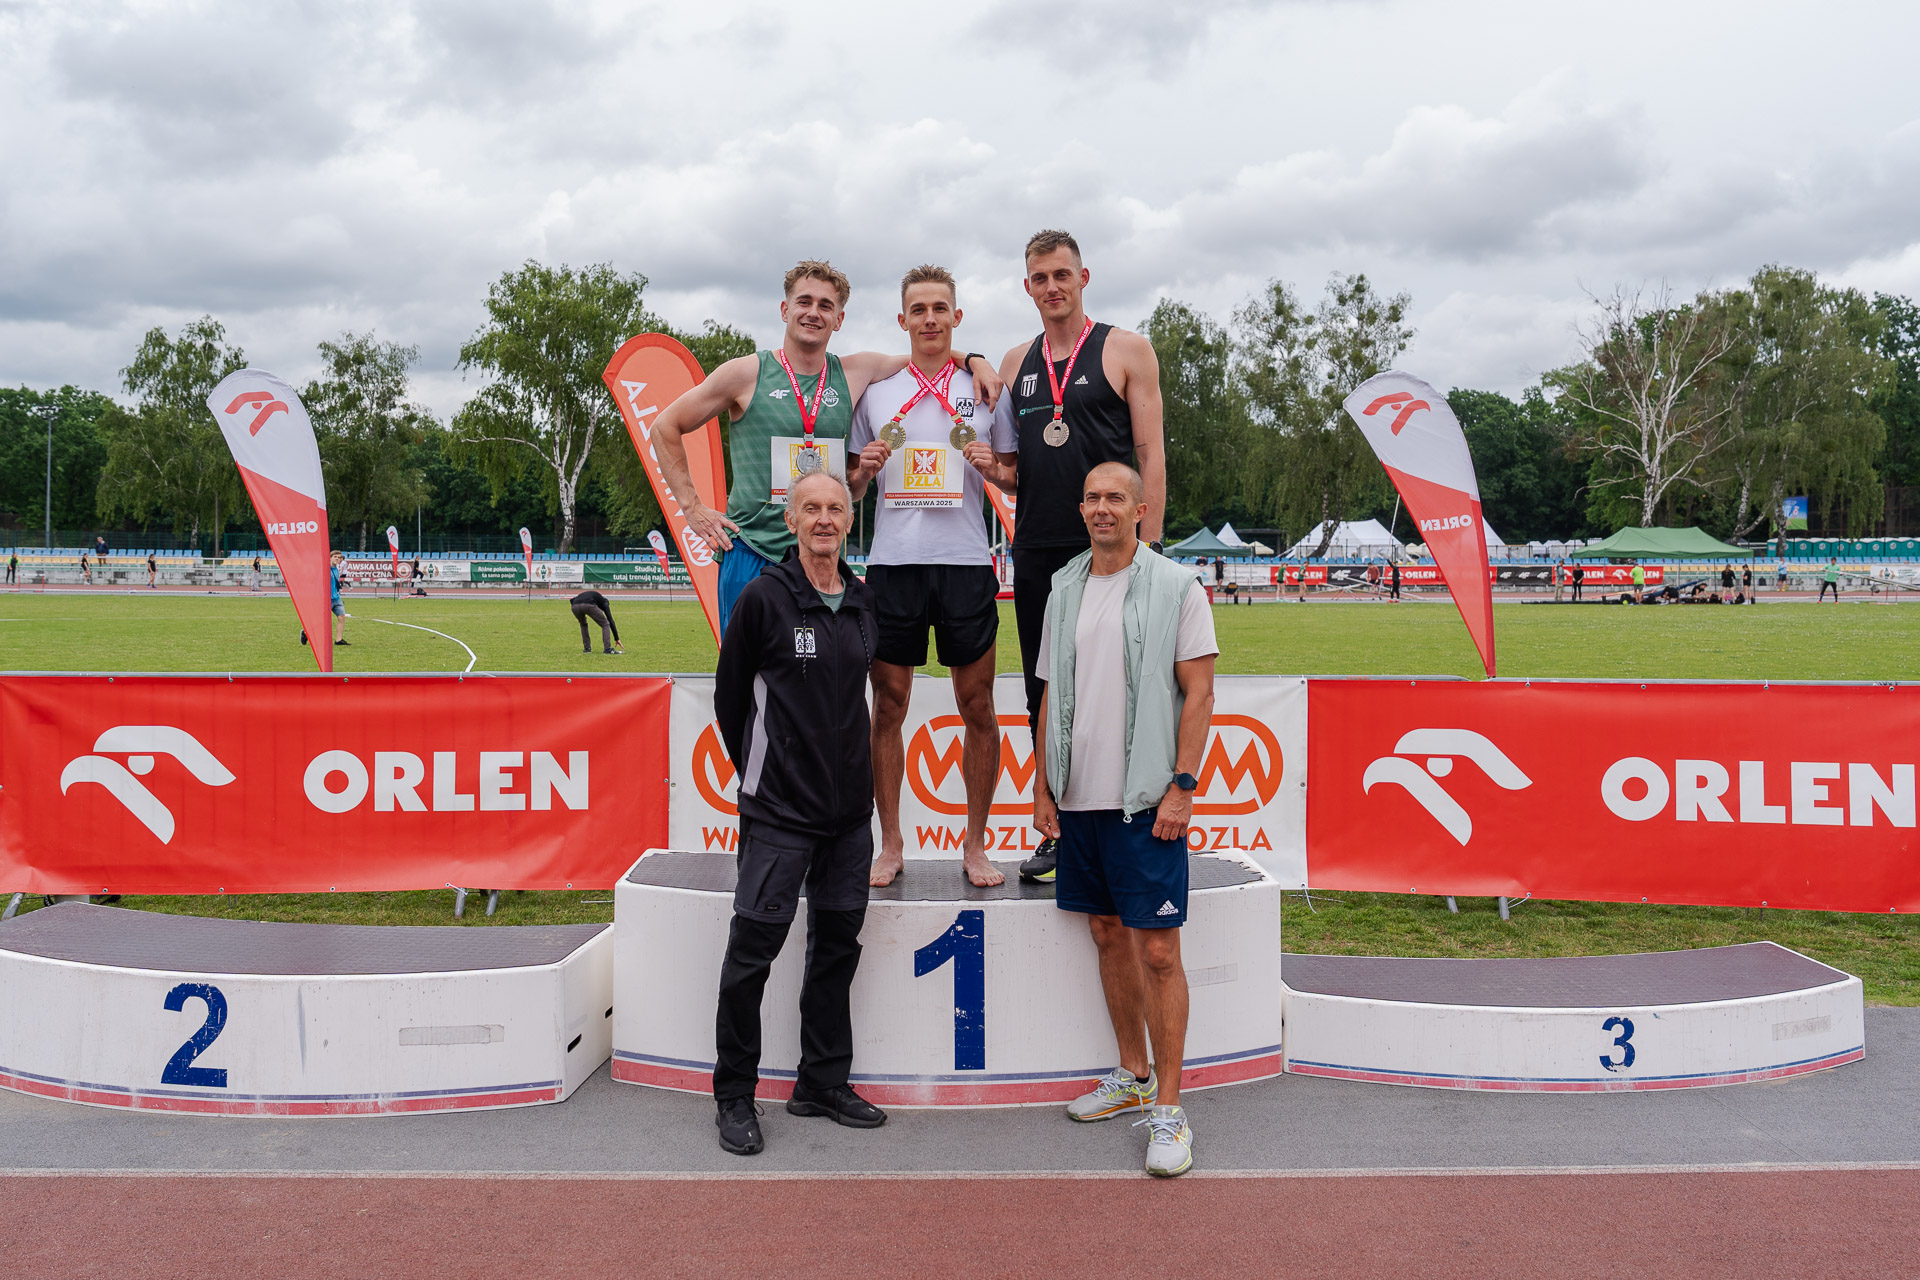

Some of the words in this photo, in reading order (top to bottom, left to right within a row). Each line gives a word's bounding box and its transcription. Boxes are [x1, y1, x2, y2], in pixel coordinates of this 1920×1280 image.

[906, 475, 941, 487] PZLA
[347, 563, 375, 571] AWSKA
[375, 563, 393, 571] LIGA
[1291, 571, 1323, 579] OLEN
[1405, 571, 1436, 579] ORLEN
[1583, 570, 1604, 578] RLEN
[303, 749, 590, 814] ORLEN
[1601, 756, 1917, 828] ORLEN
[916, 825, 1047, 852] WMZL
[1187, 825, 1273, 852] OZLA
[1156, 908, 1179, 916] adidas
[913, 909, 986, 1071] 1
[161, 982, 228, 1088] 2
[1598, 1016, 1636, 1073] 3
